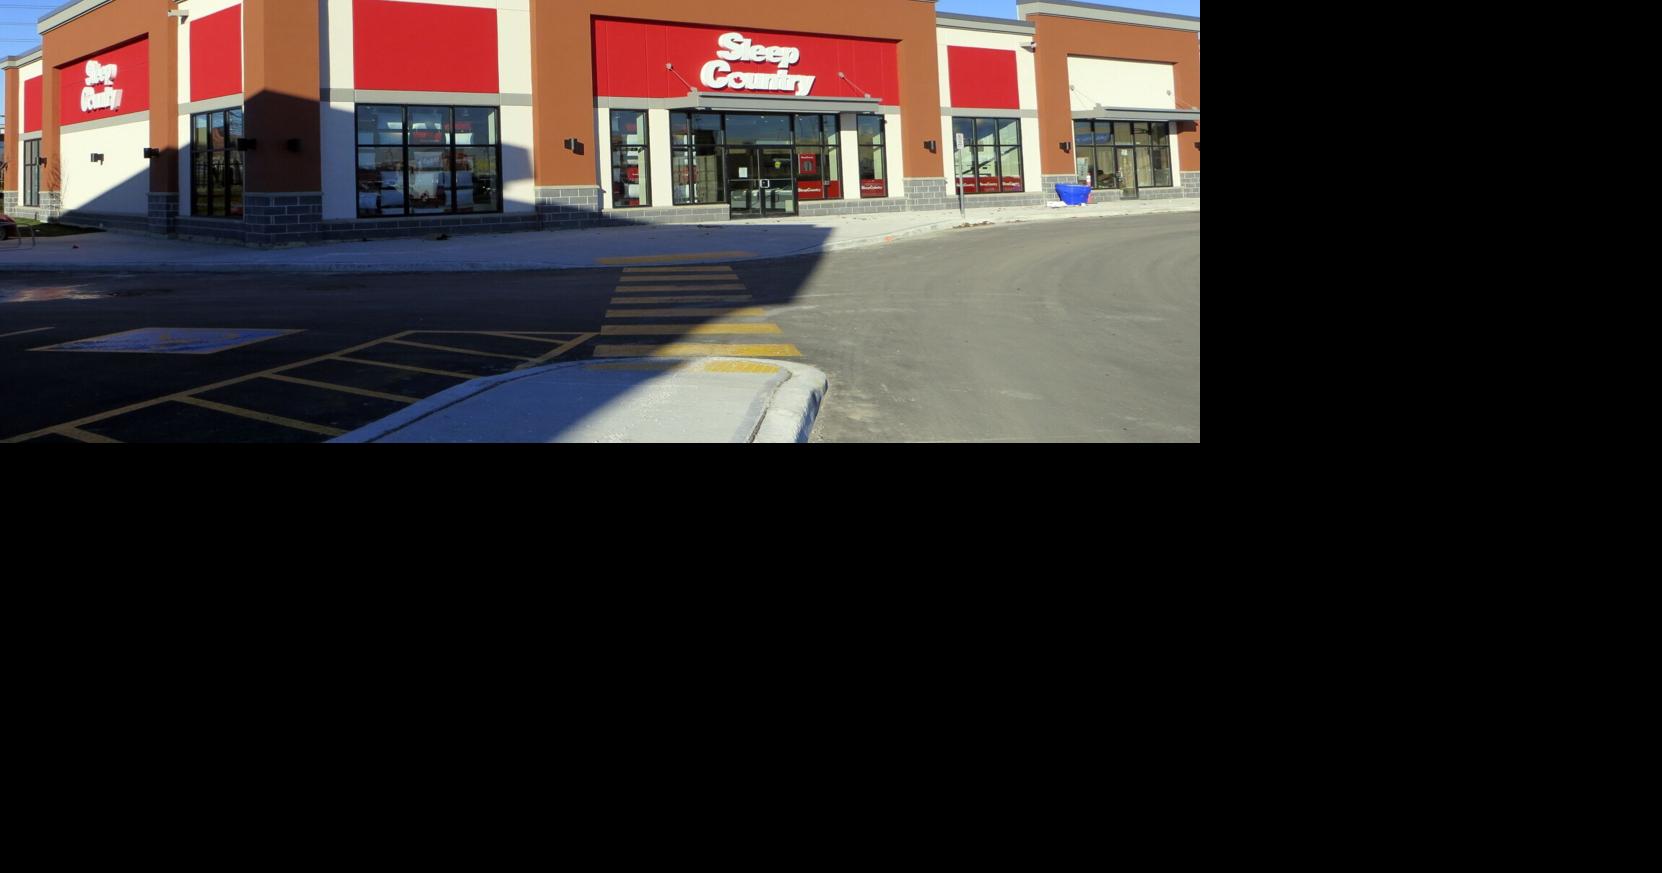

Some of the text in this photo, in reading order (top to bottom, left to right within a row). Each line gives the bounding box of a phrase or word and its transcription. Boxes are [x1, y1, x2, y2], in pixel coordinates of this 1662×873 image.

[716, 32, 800, 68] Sleep
[85, 60, 117, 85] Sleep
[700, 59, 816, 96] Country
[81, 86, 123, 112] Country
